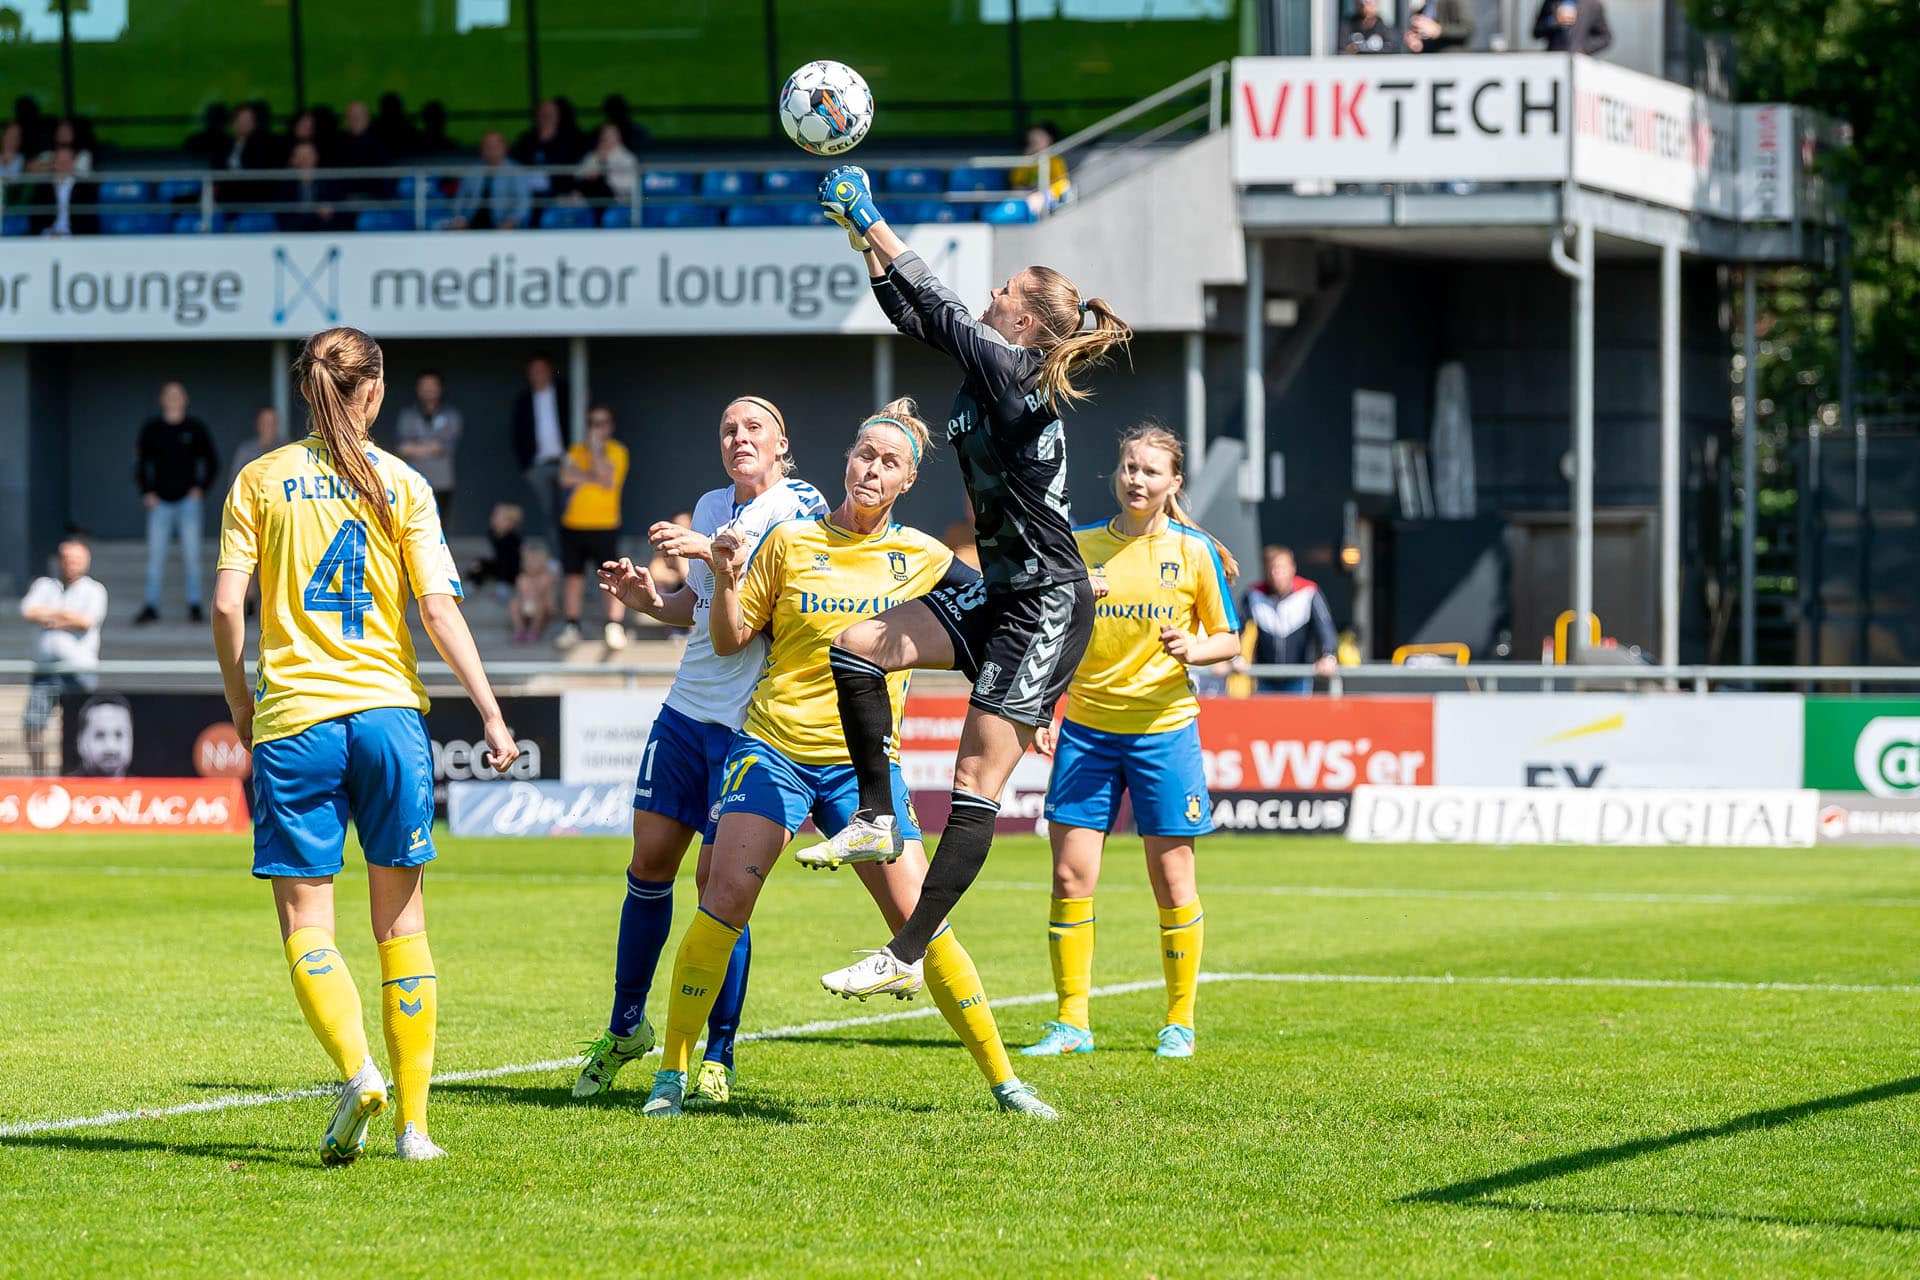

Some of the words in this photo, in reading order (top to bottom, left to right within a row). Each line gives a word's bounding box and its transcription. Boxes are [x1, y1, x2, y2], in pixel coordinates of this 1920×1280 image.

[828, 120, 869, 153] SELECT
[1242, 80, 1559, 149] VIKTECH
[51, 260, 243, 327] lounge
[370, 252, 637, 310] mediator
[659, 253, 860, 319] lounge
[303, 519, 373, 640] 4
[1212, 799, 1346, 830] ARCLUB
[1369, 798, 1575, 842] DIGITAL
[1598, 800, 1806, 846] DIGITAL
[681, 984, 708, 998] BIF
[959, 993, 982, 1010] BIF
